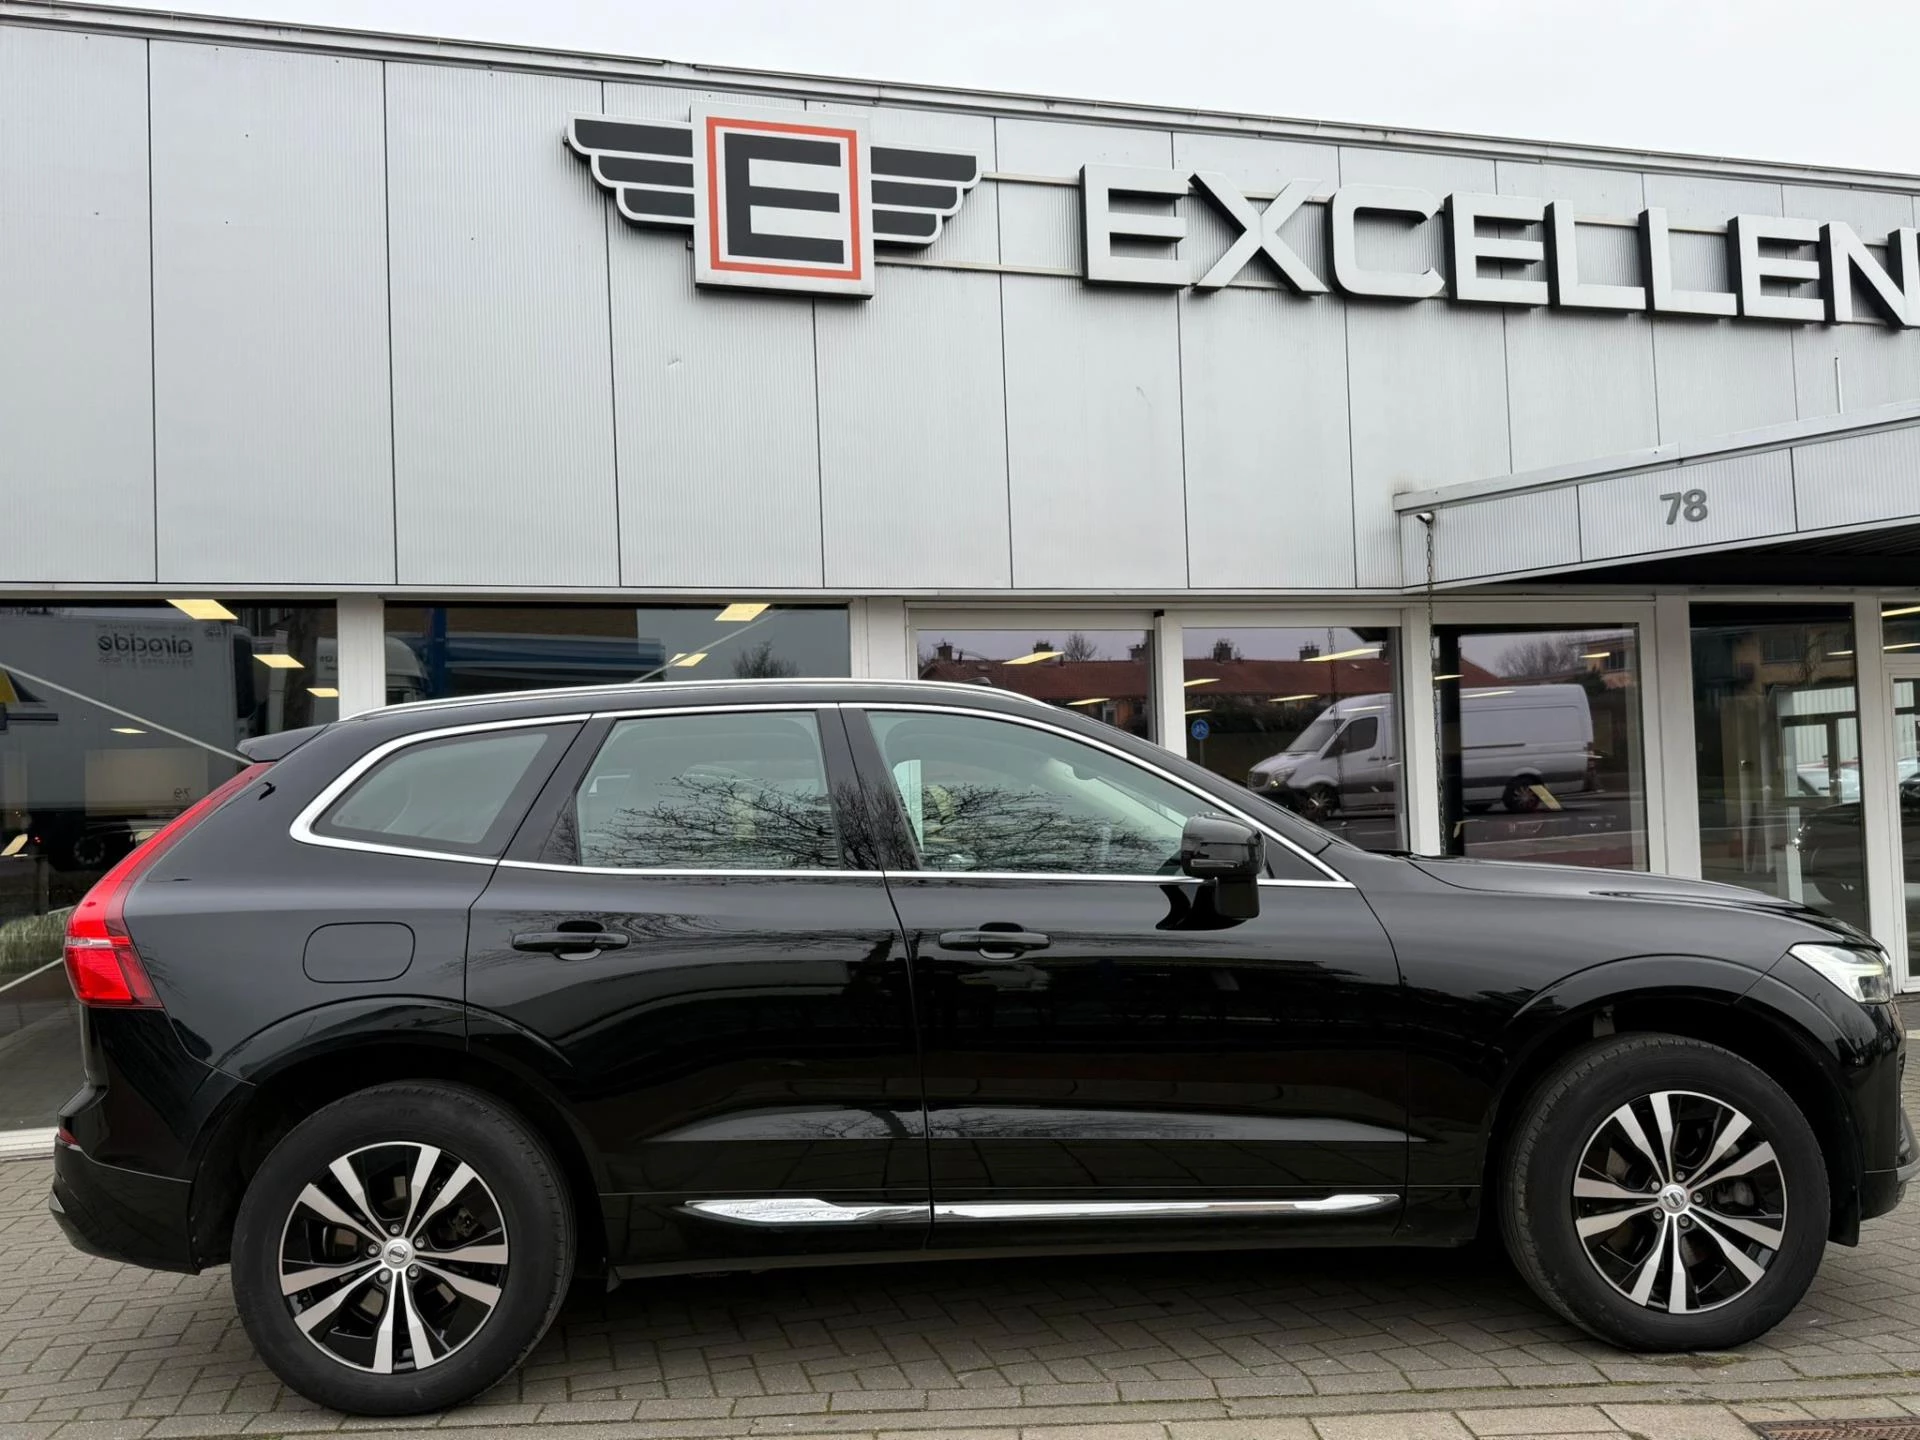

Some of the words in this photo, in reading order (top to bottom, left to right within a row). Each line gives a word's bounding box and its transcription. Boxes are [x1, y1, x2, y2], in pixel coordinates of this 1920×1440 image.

[723, 132, 845, 264] E
[1081, 163, 1920, 328] EXCELLEN
[1660, 488, 1708, 525] 78
